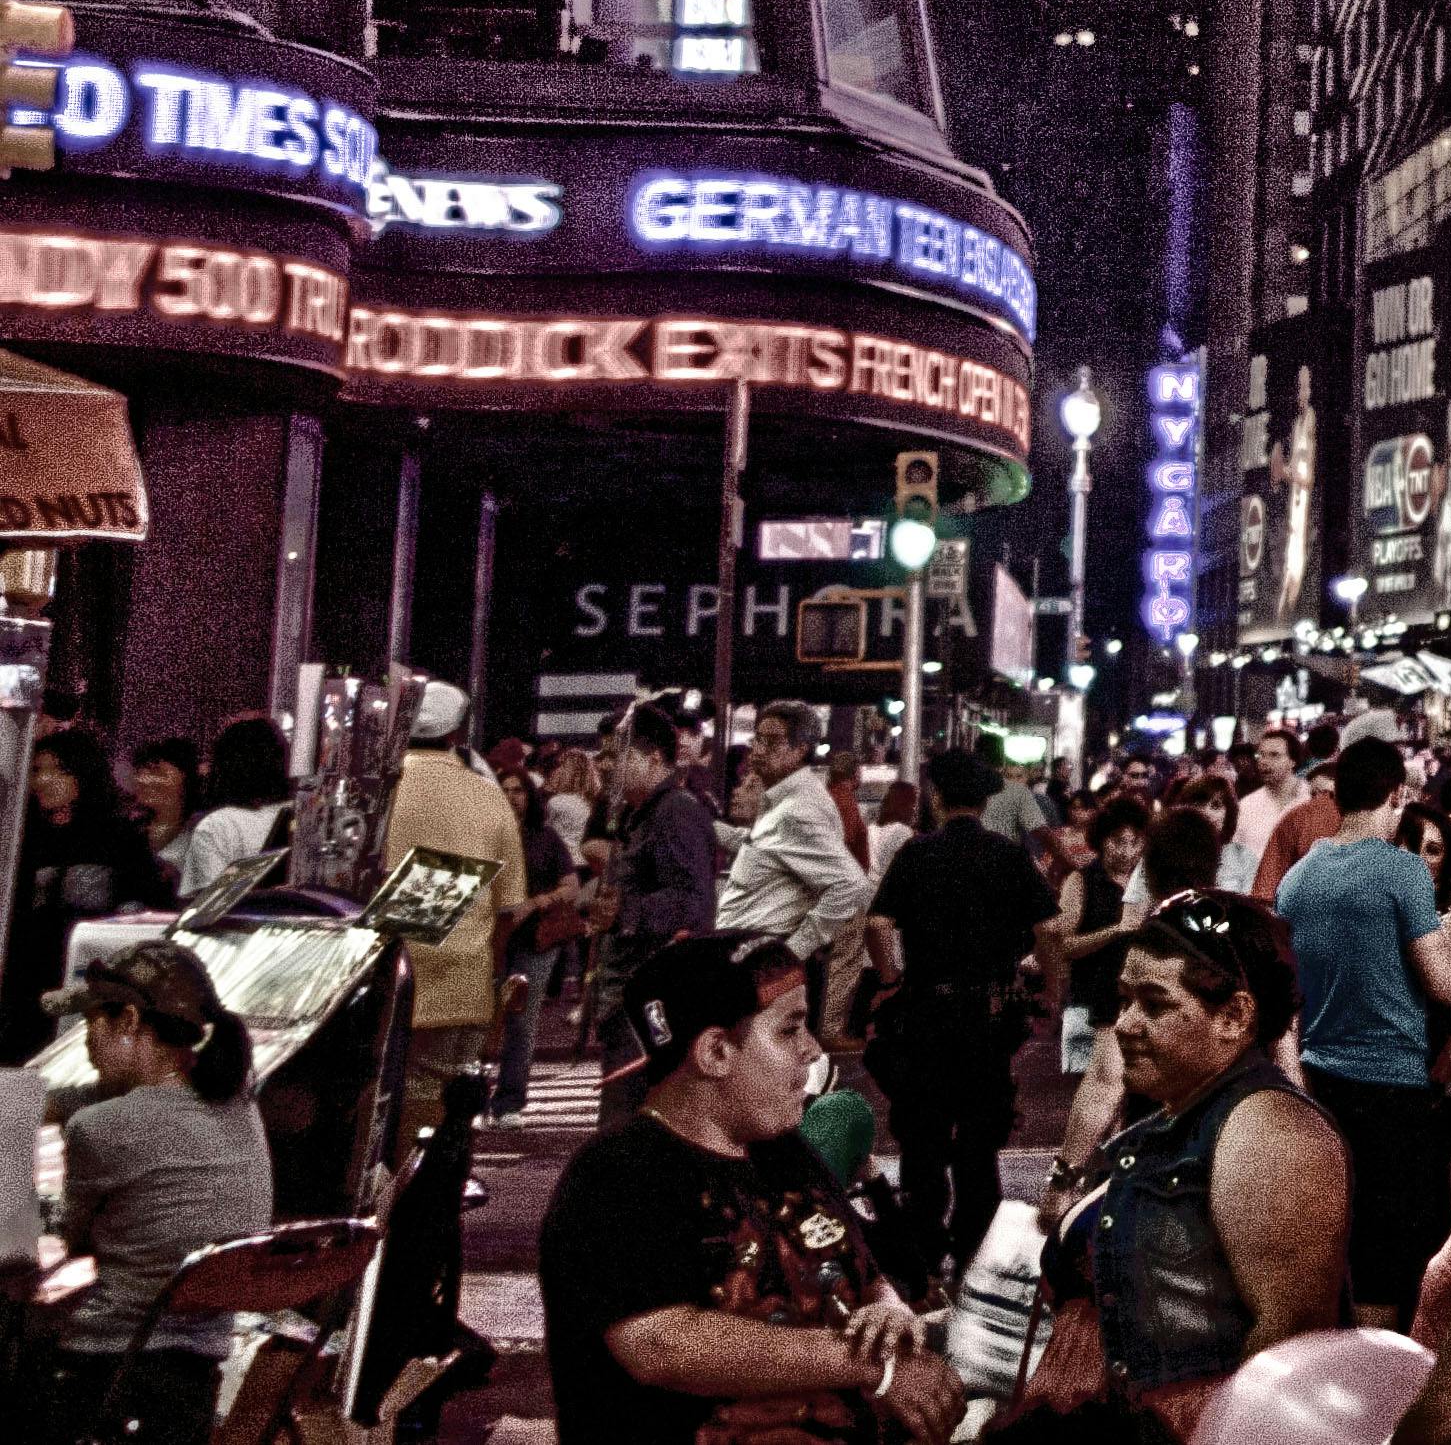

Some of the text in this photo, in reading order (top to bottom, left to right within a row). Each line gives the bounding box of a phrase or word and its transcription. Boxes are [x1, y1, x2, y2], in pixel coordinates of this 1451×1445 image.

[137, 71, 320, 166] TIMES
[632, 176, 893, 257] GERMAN
[154, 245, 278, 323] 500
[652, 318, 850, 389] EXITS
[851, 333, 958, 414] FRENCH
[33, 490, 138, 529] NUTS
[1408, 468, 1430, 496] TNT
[573, 583, 979, 639] SEPHRA
